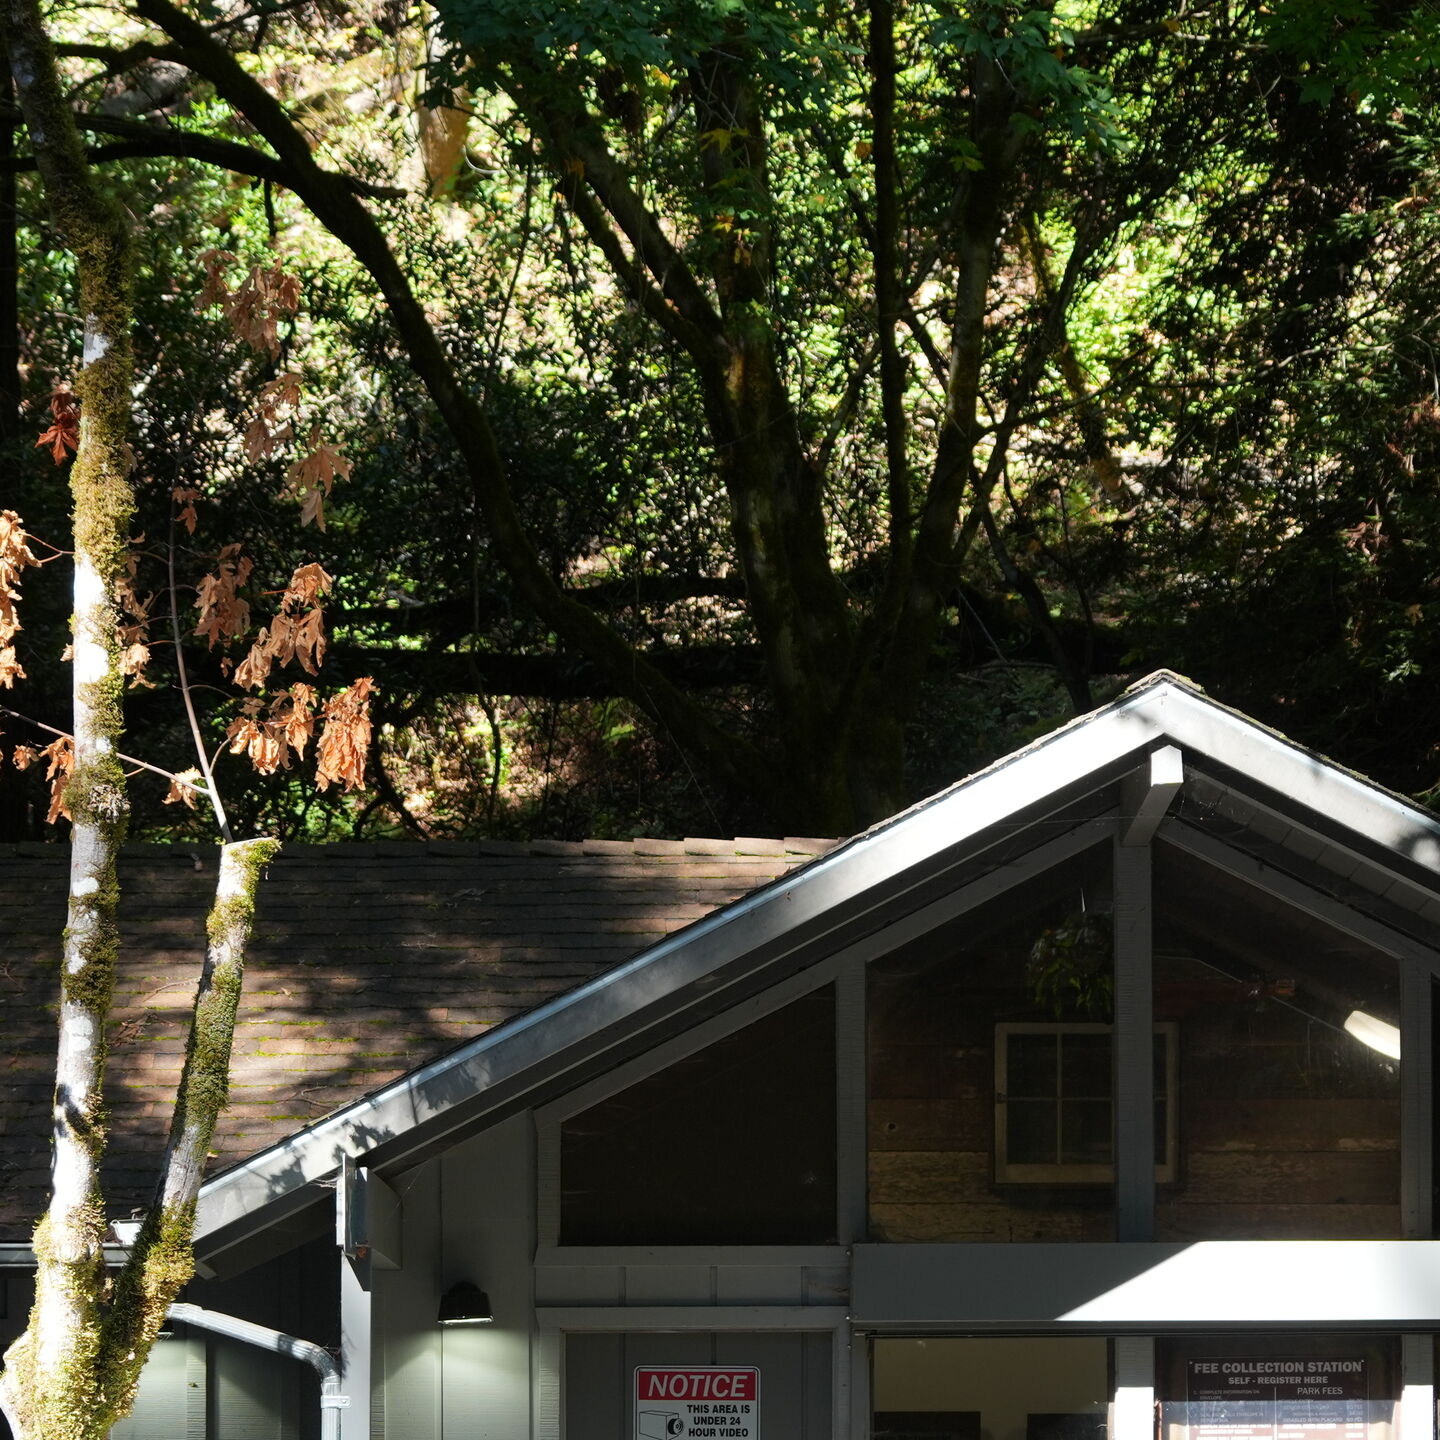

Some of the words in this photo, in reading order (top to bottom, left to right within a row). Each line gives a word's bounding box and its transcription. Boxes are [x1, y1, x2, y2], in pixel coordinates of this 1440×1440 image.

[1194, 1363, 1219, 1374] FEE
[1222, 1362, 1304, 1374] COLLECTION
[1308, 1361, 1362, 1373] STATION
[1258, 1376, 1302, 1384] REGISTER
[648, 1374, 748, 1398] NOTICE
[1297, 1387, 1320, 1395] PARK
[687, 1405, 710, 1414] THIS
[712, 1405, 739, 1414] AREA
[741, 1405, 750, 1414] IS
[694, 1416, 727, 1425] UNDER
[730, 1416, 741, 1425] 24
[688, 1428, 716, 1437] HOUR
[719, 1428, 748, 1437] VIDEO
